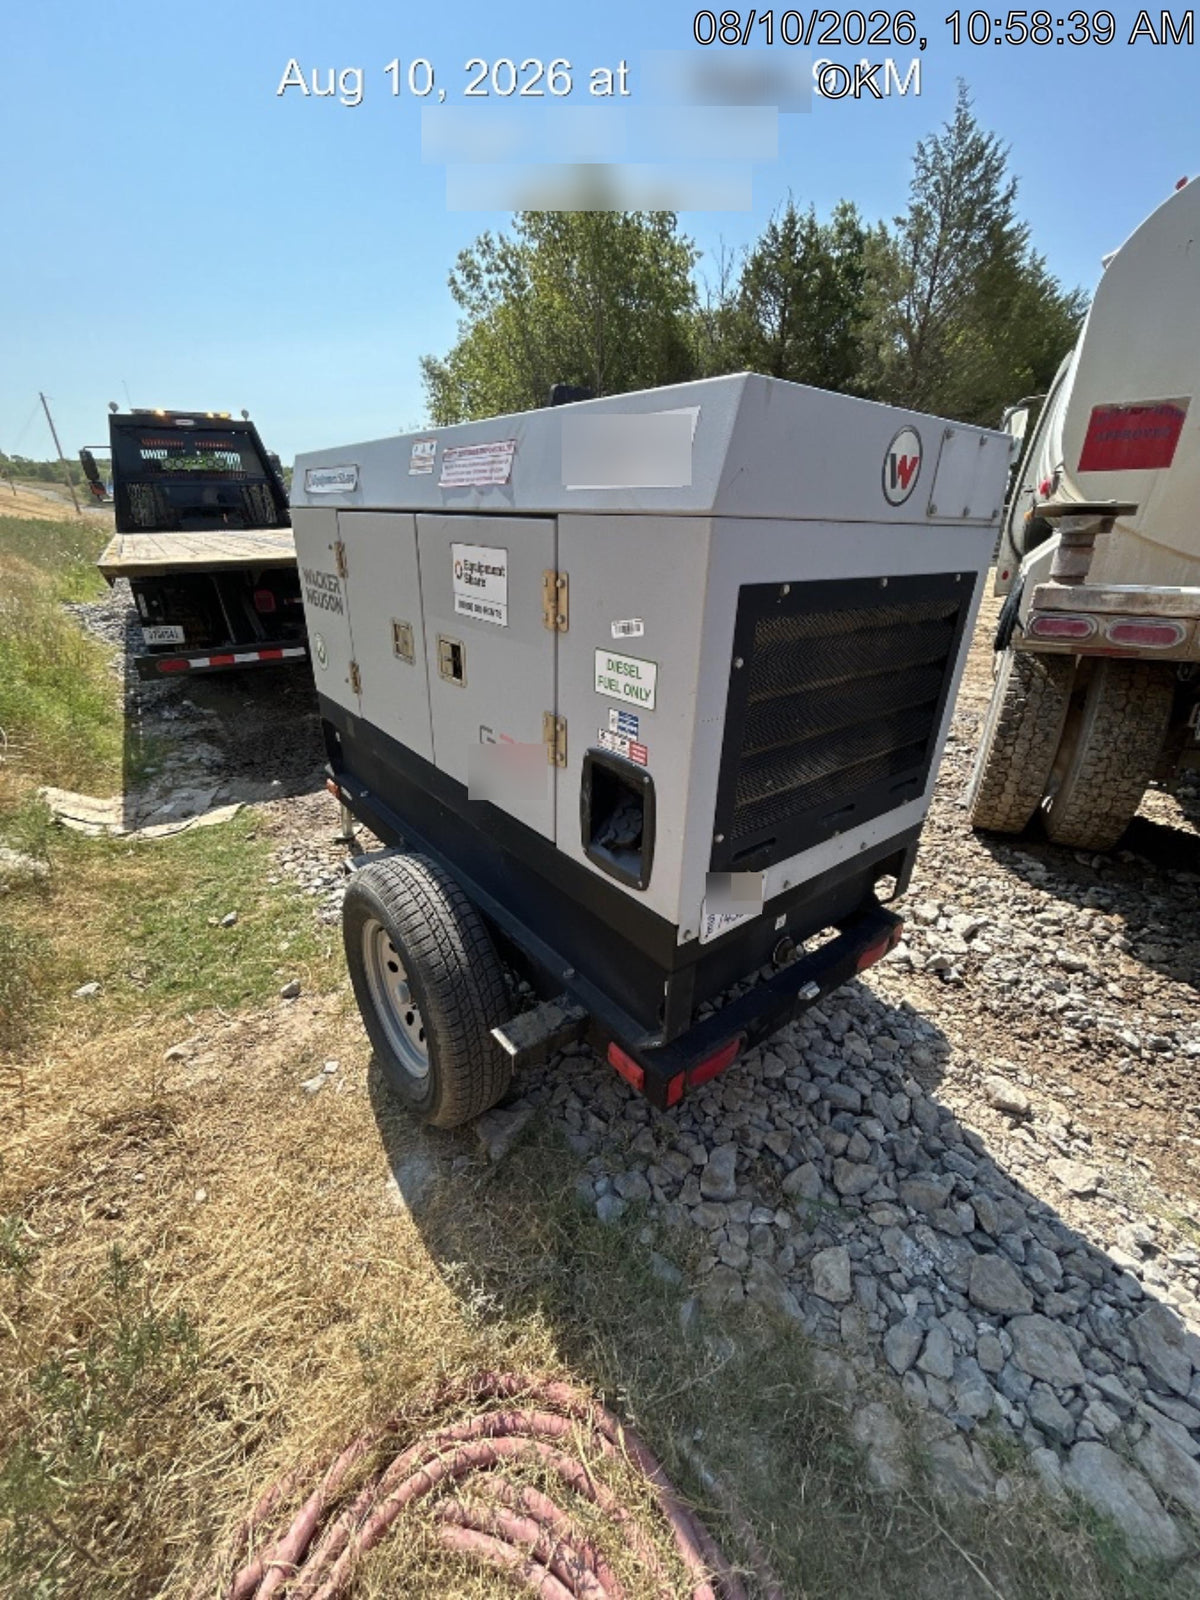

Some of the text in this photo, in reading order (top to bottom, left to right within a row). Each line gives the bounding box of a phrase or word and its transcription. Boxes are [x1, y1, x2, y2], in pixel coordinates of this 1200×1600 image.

[606, 658, 643, 680] DIESEL
[597, 675, 652, 702] FUEL ONLY
